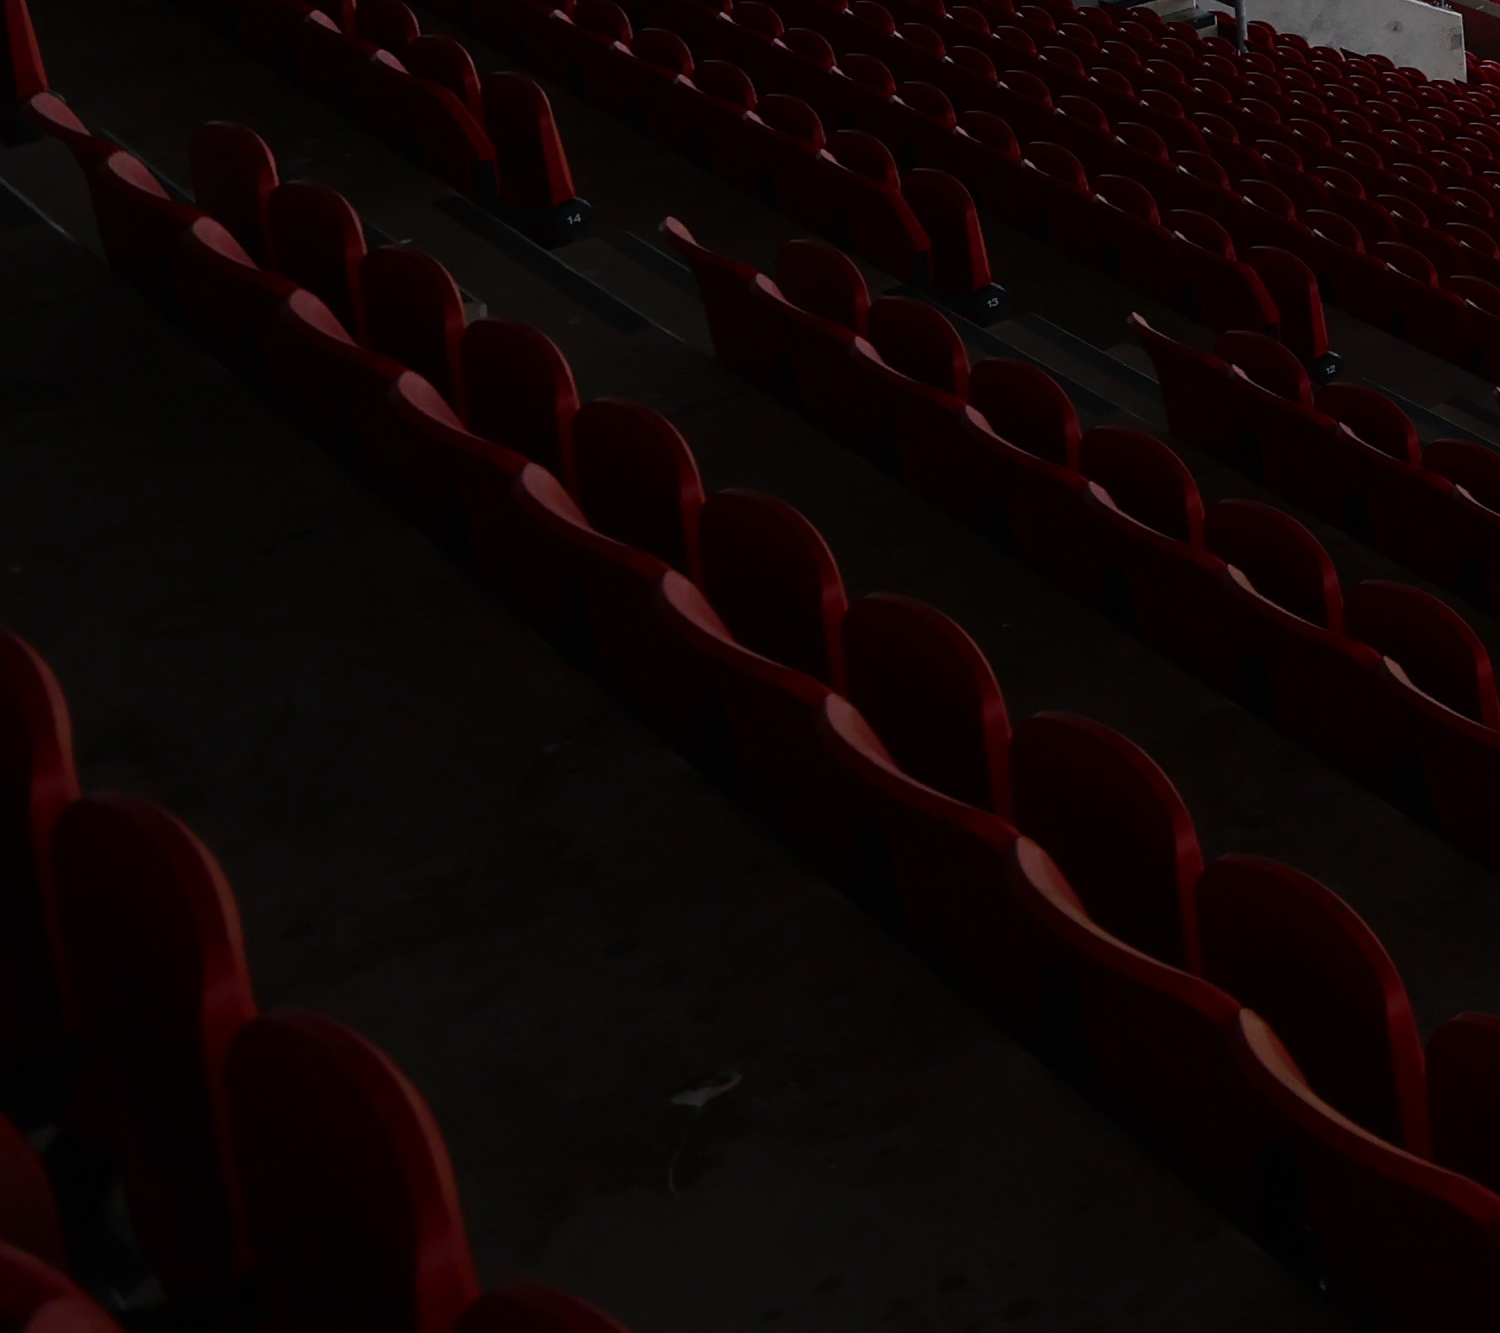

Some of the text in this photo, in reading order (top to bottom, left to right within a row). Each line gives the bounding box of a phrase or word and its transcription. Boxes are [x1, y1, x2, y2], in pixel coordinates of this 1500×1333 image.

[566, 213, 582, 225] 14
[987, 297, 999, 308] 13
[1326, 364, 1336, 374] 12
